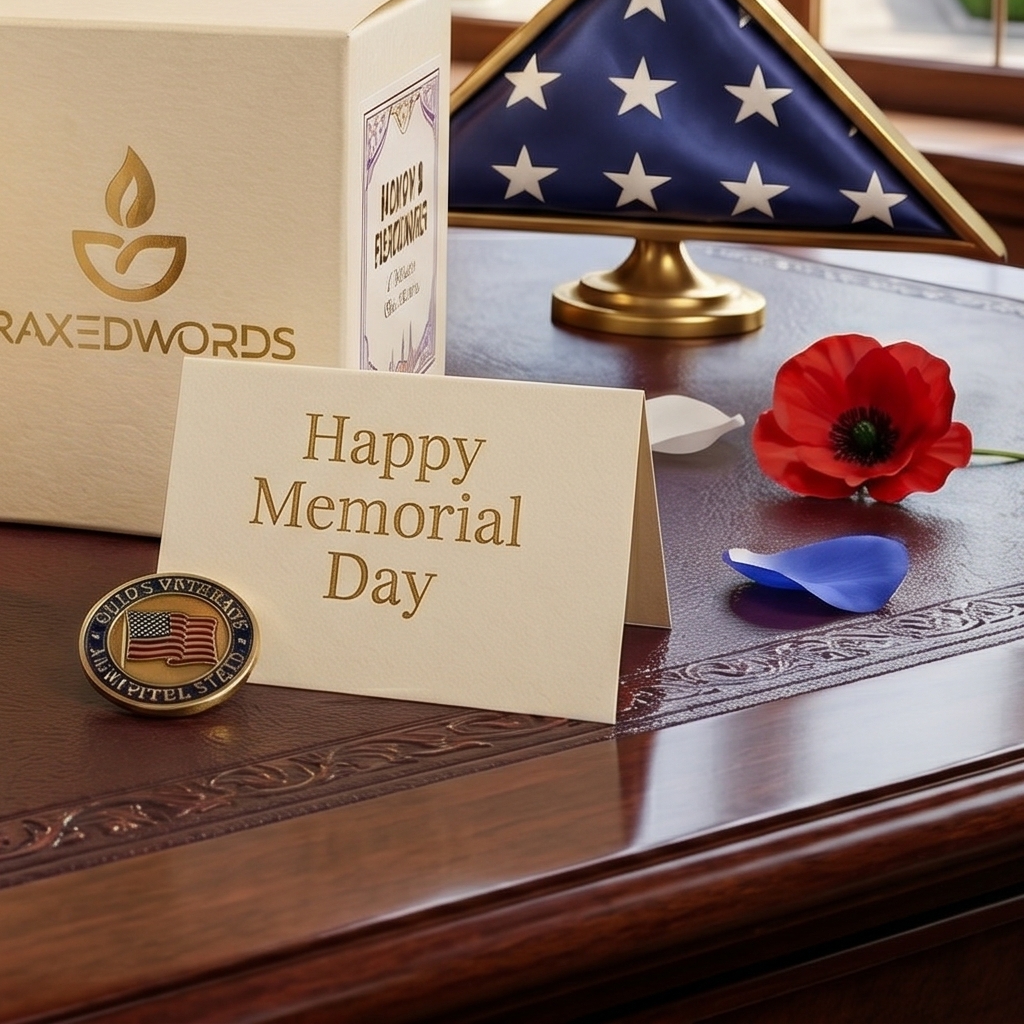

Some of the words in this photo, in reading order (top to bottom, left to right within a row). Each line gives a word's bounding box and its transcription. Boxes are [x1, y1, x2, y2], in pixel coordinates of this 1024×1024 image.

[302, 412, 487, 485] Happy
[248, 476, 522, 547] Memorial
[322, 551, 438, 619] Day
